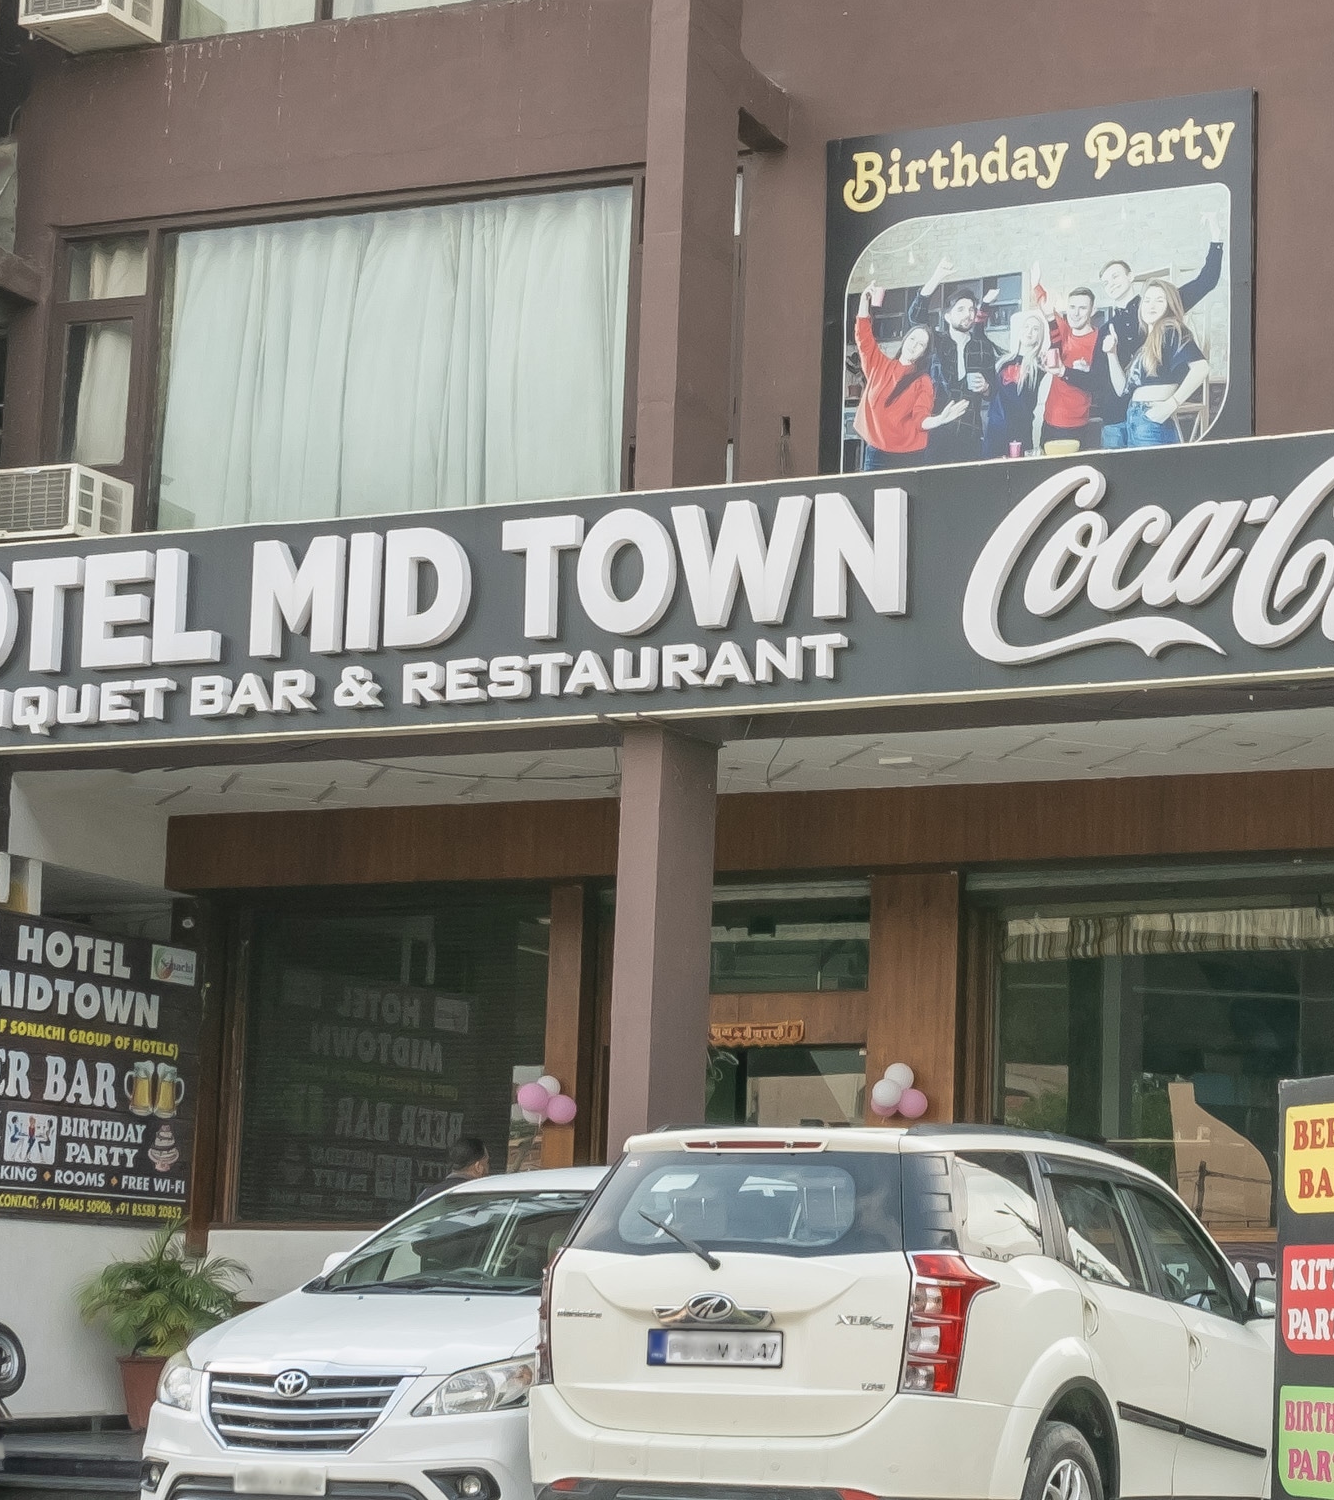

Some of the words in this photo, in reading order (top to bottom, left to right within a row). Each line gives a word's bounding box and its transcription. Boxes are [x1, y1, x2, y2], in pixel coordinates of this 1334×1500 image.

[843, 134, 1069, 213] Birthday
[1084, 117, 1235, 180] Party
[250, 527, 472, 660] MID
[501, 480, 908, 642] TOWN
[190, 668, 316, 720] BAR
[333, 666, 385, 709] &
[401, 633, 848, 705] RESTAURANT
[17, 924, 131, 980] HOTEL
[10, 1022, 66, 1042] SONACHI
[69, 1029, 111, 1048] GROUP
[114, 1036, 130, 1050] OF
[43, 1055, 117, 1109] BAR
[60, 1116, 147, 1144] BIRTHDAY
[65, 1143, 139, 1168] PARTY
[54, 1170, 106, 1188] ROOMS
[121, 1175, 150, 1192] FREE
[153, 1178, 185, 1194] WI-FI
